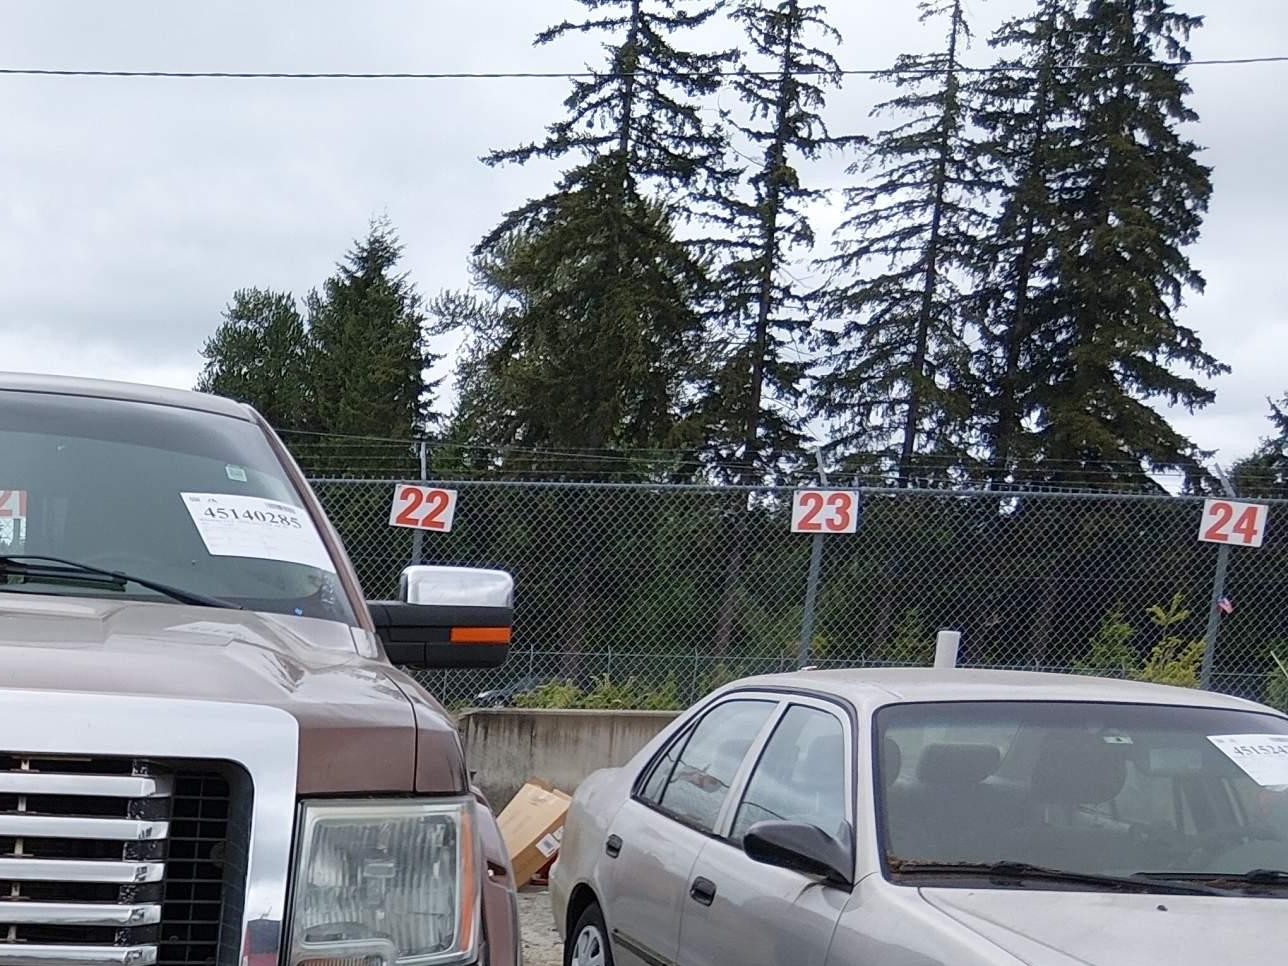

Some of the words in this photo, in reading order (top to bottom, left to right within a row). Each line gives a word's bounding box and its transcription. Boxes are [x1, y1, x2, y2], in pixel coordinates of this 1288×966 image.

[204, 507, 302, 529] 45140285
[396, 487, 449, 529] 22
[798, 492, 851, 531] 23
[1204, 502, 1258, 544] 24
[1233, 745, 1288, 755] 451524
